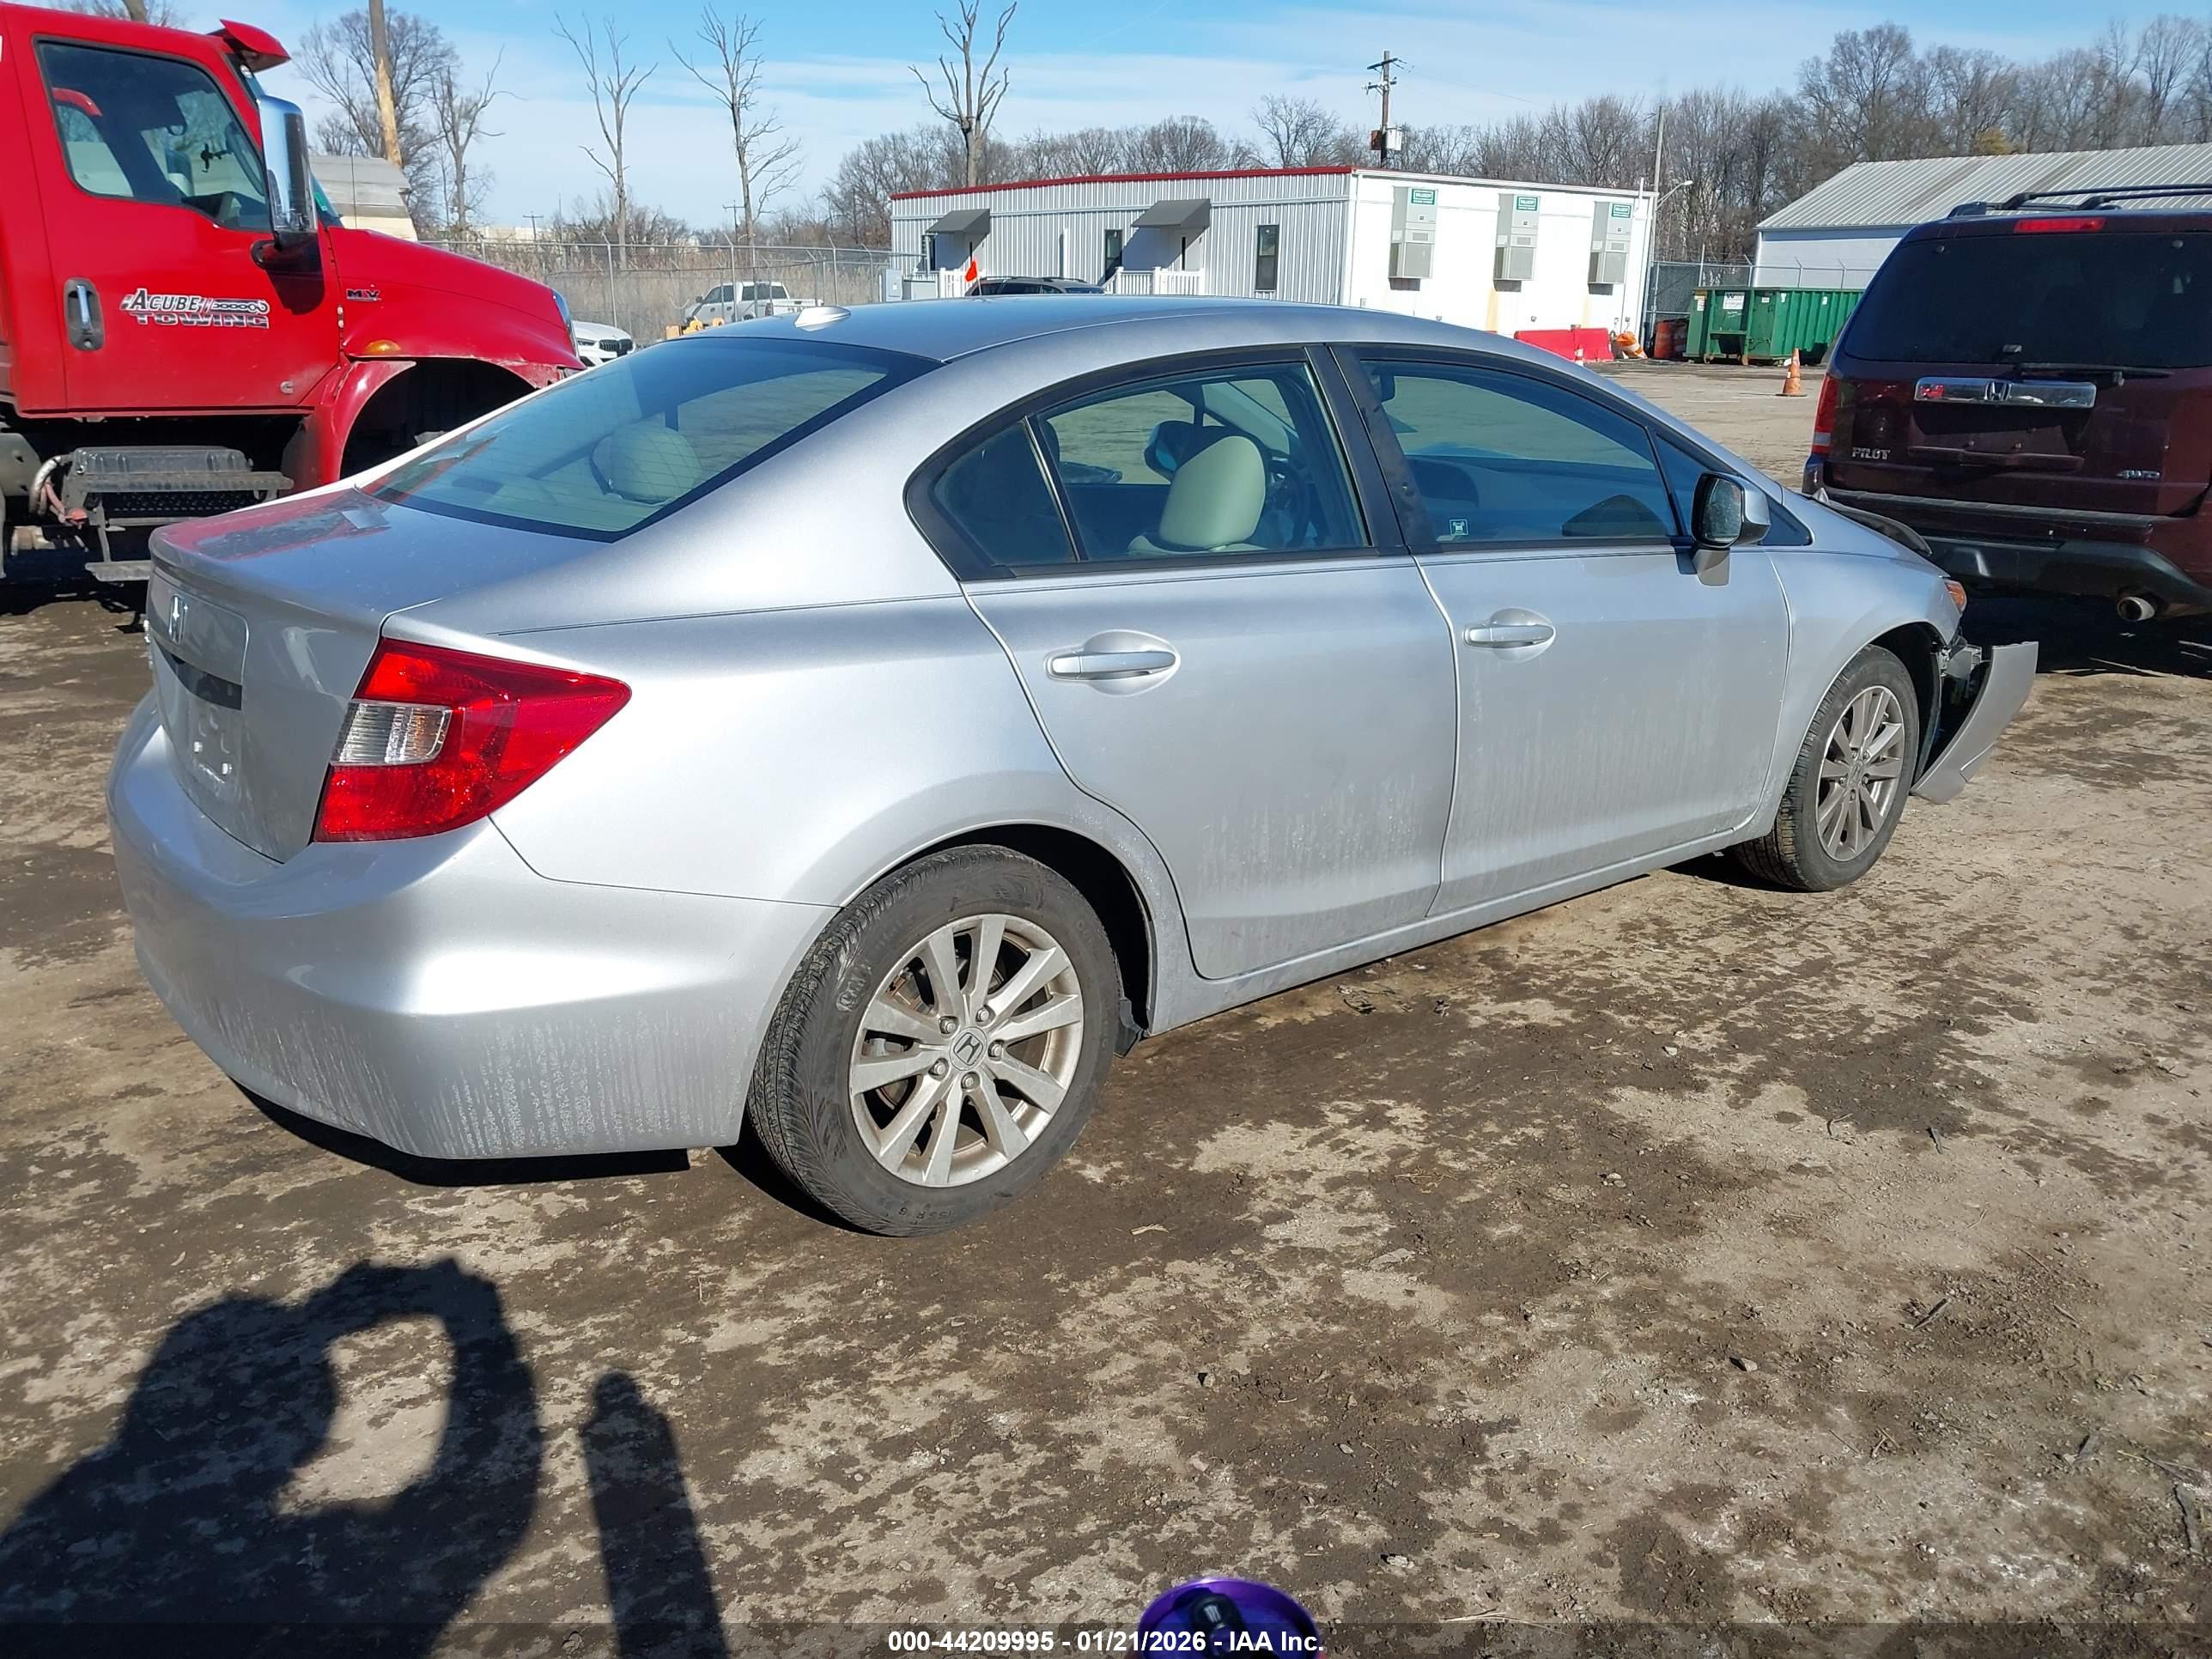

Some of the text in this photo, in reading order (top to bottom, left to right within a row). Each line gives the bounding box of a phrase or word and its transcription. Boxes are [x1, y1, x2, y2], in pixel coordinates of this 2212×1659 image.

[129, 288, 201, 312] ACUBE
[131, 312, 270, 329] TOWING
[1852, 447, 1891, 459] PILOT
